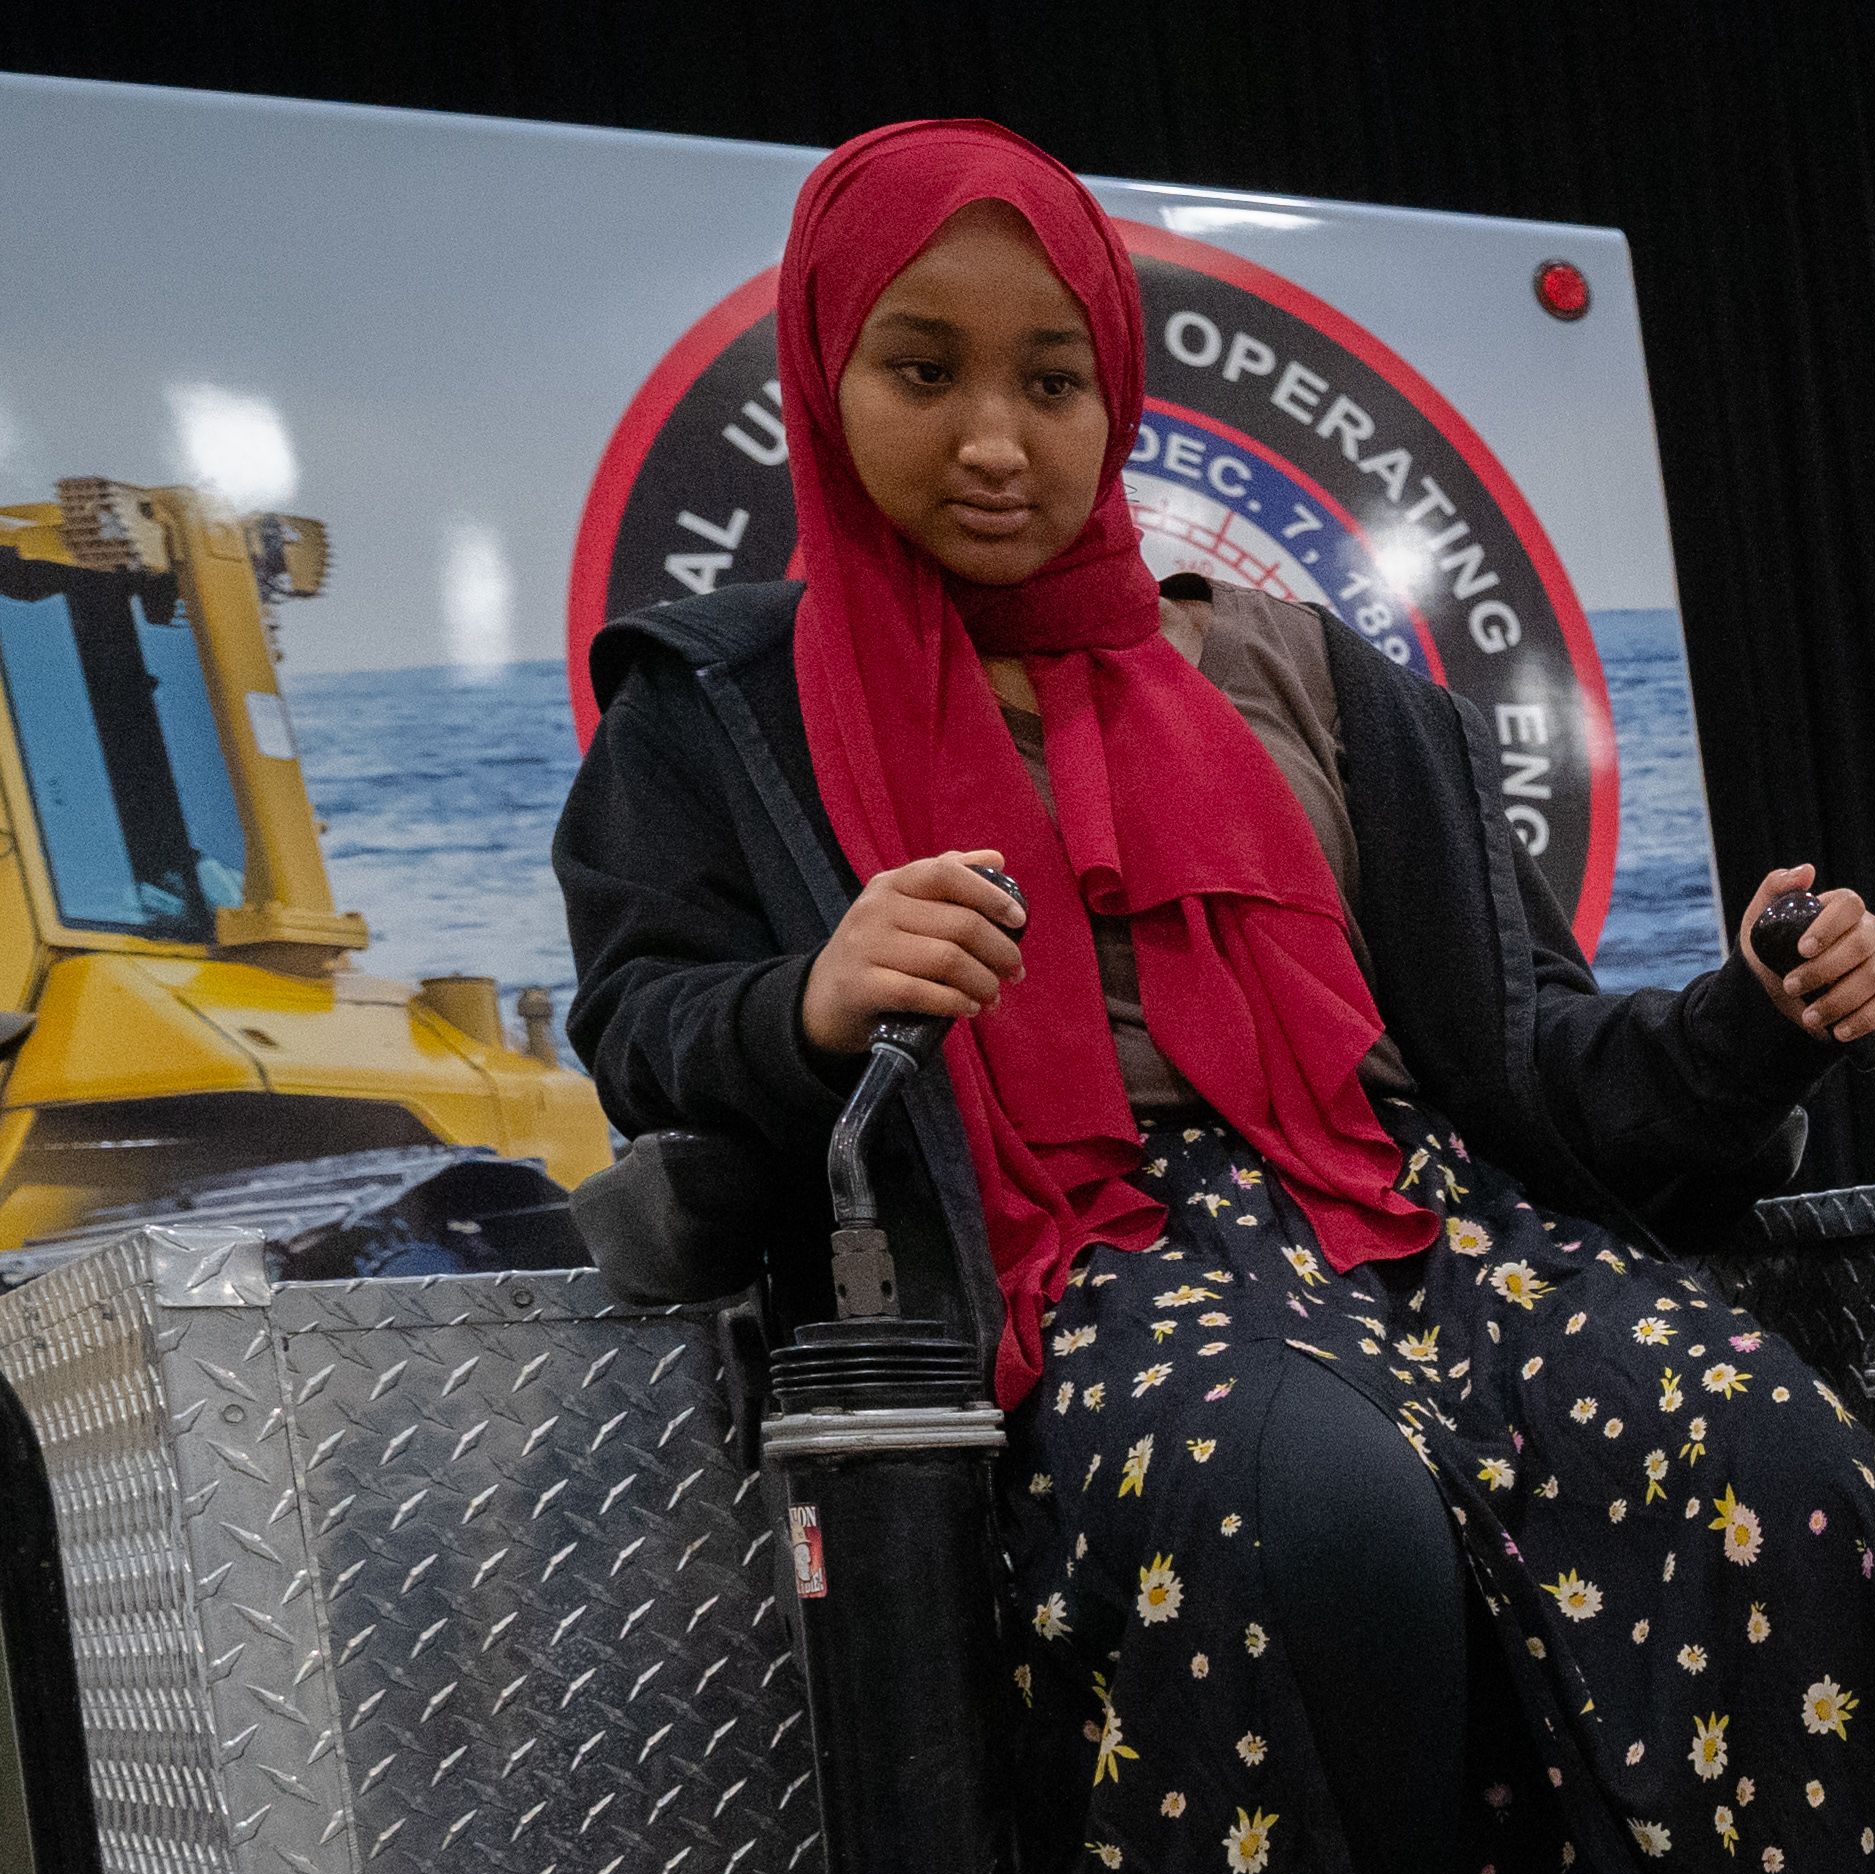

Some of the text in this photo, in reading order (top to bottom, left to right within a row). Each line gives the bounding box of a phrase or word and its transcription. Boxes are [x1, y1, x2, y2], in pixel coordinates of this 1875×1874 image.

[662, 506, 750, 606] AL
[721, 379, 790, 467] U
[1163, 309, 1523, 654] OPERATING
[1128, 423, 1263, 513] DEC.
[1282, 503, 1325, 566] 7,
